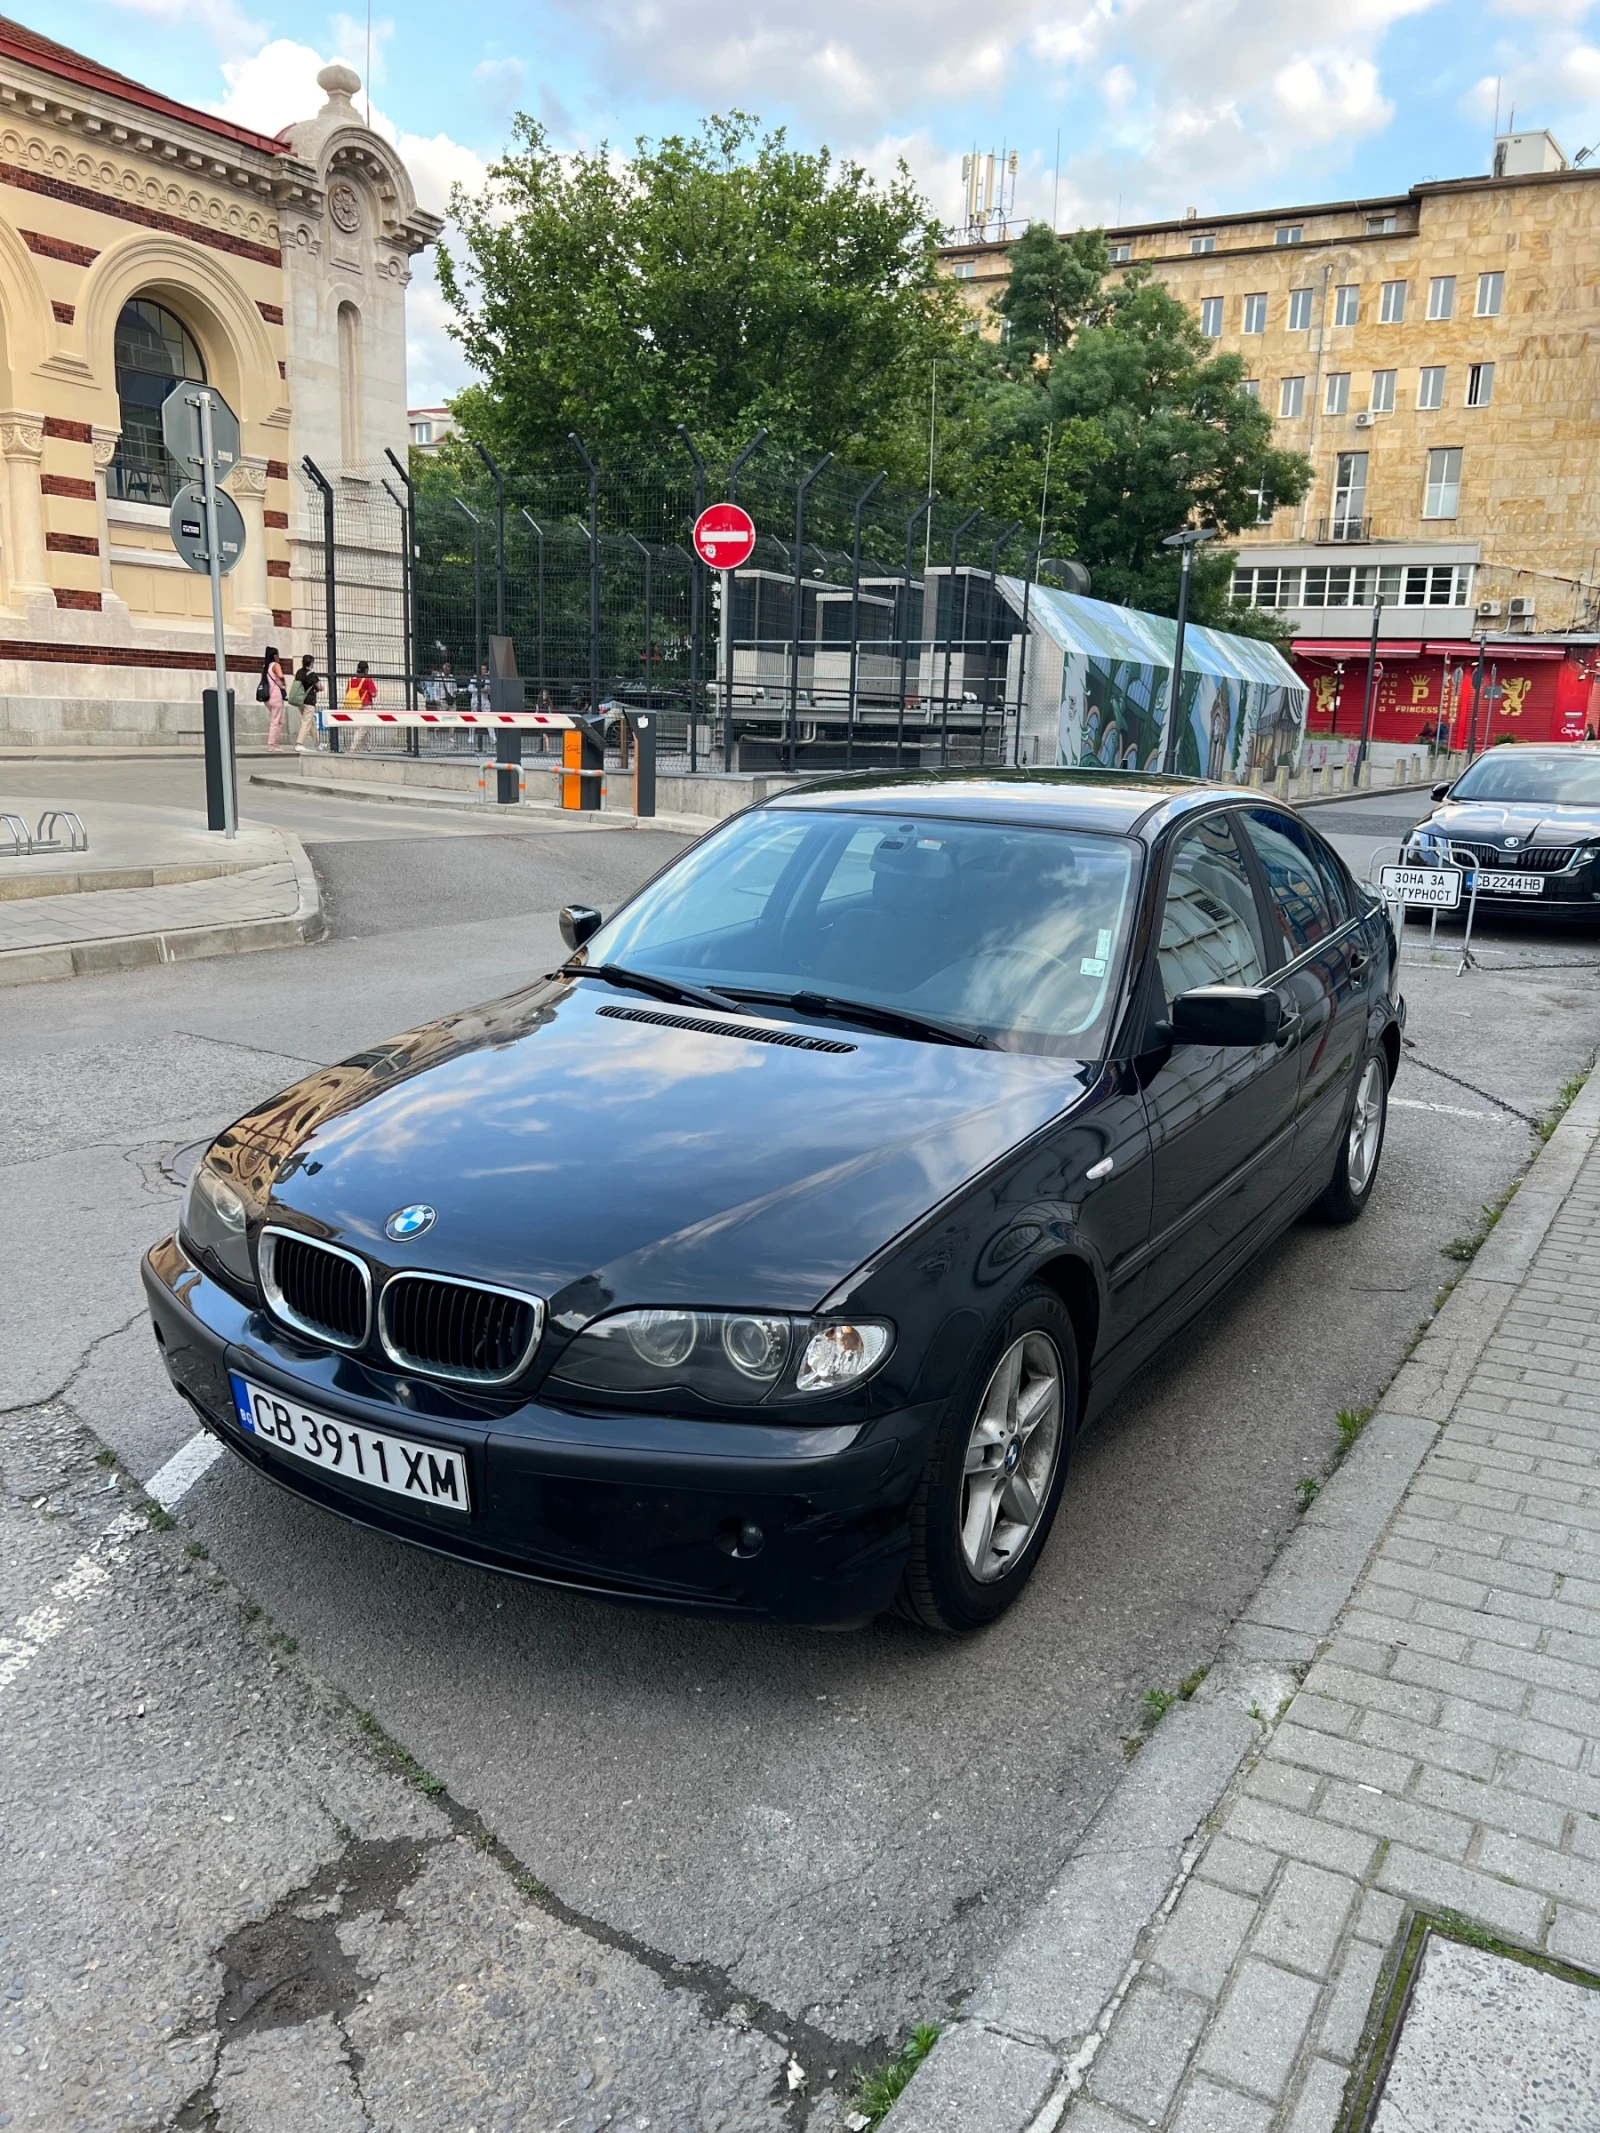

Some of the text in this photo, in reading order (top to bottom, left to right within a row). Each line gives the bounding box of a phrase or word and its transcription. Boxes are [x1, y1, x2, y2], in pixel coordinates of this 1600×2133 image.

[1412, 686, 1429, 704] P
[1395, 704, 1439, 714] PRINCESS
[1395, 872, 1445, 886] ЗОНА ЗА
[1492, 876, 1522, 889] 2244
[240, 1408, 253, 1426] BG
[253, 1393, 459, 1502] CB 3911 XM
